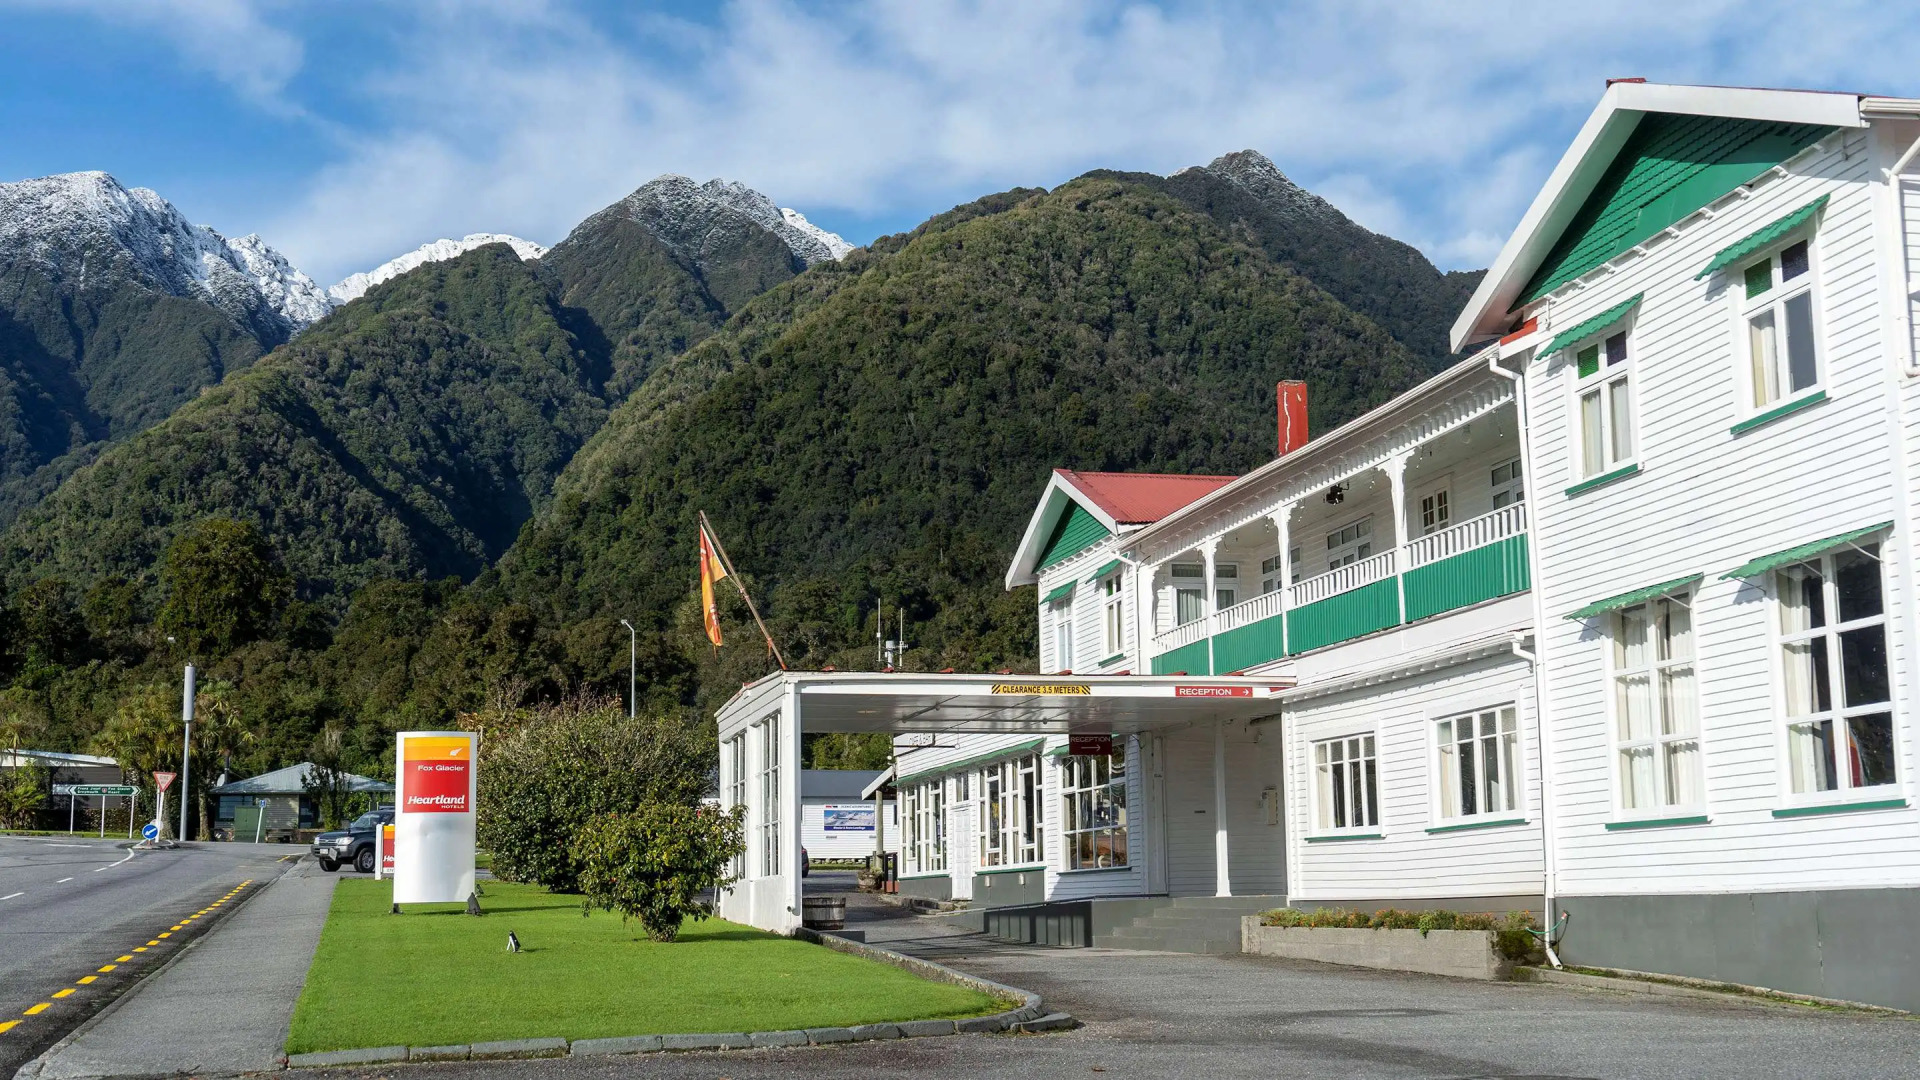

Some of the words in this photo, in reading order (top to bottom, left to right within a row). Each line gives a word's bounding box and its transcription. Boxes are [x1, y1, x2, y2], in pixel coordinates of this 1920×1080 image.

[1002, 685, 1041, 694] CLEARANCE
[1042, 686, 1052, 694] 3.5
[1053, 686, 1080, 694] METERS
[407, 794, 465, 805] Heartland
